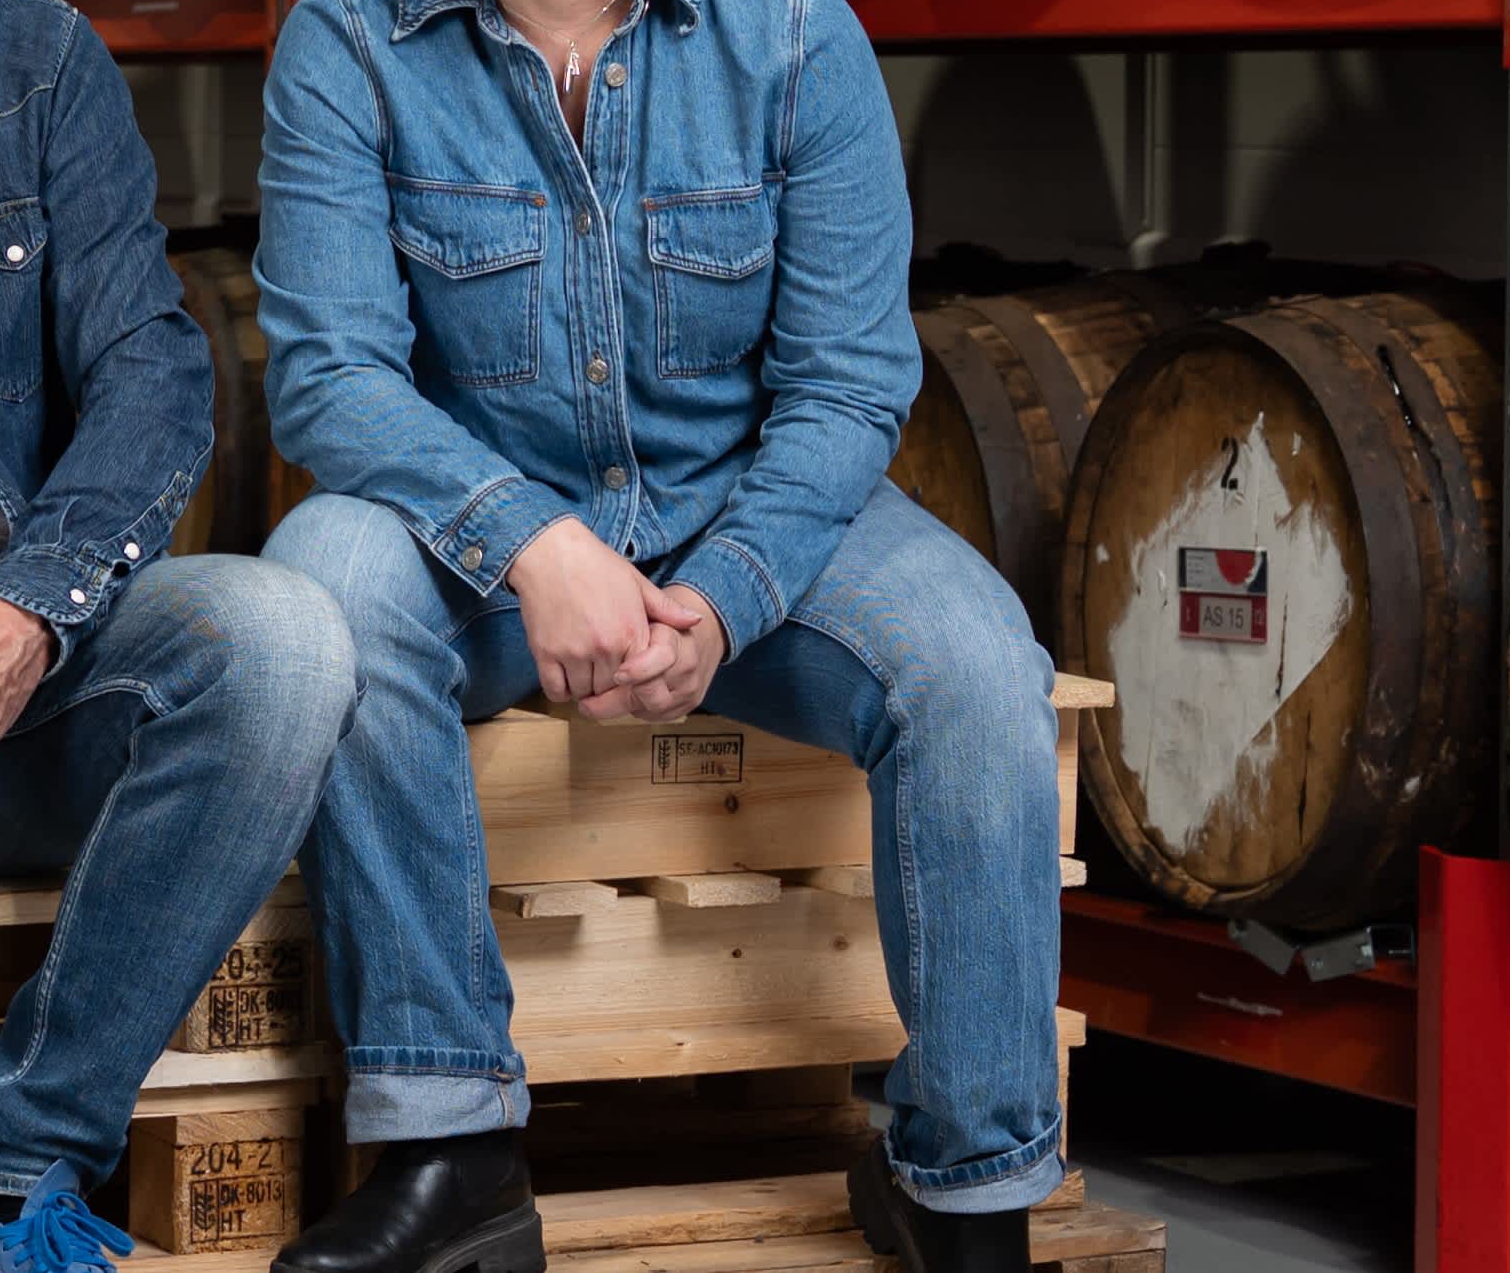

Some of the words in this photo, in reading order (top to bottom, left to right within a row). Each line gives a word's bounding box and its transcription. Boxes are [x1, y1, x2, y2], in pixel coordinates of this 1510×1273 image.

[1220, 436, 1240, 491] 2
[1202, 603, 1225, 629] AS
[1228, 605, 1245, 631] 15
[221, 1209, 247, 1233] HT
